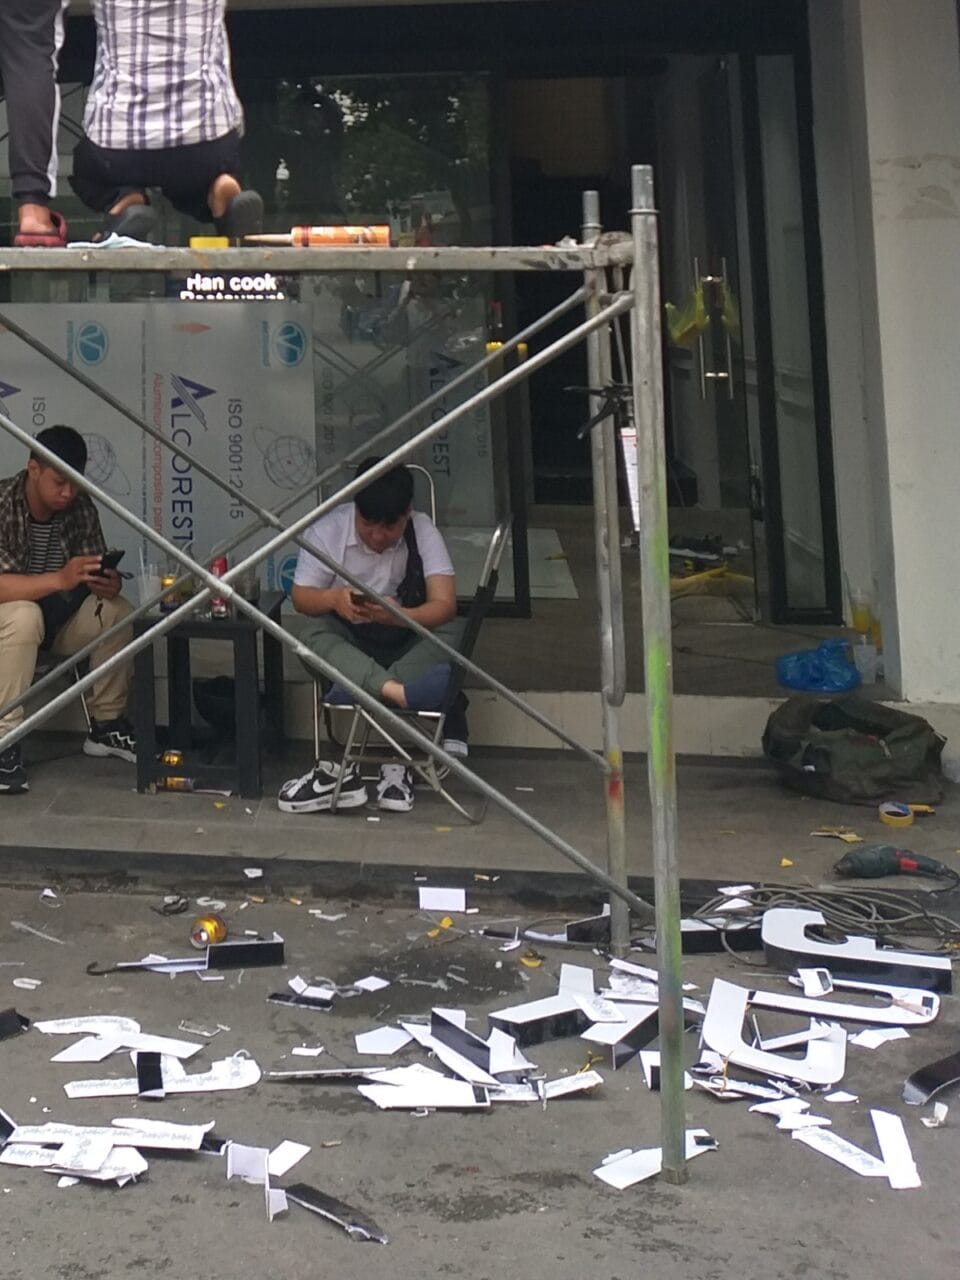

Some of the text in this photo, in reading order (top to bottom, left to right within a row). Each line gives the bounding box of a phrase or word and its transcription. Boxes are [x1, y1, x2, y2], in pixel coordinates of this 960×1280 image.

[229, 273, 277, 291] cook
[227, 397, 244, 519] ISO 9001:215
